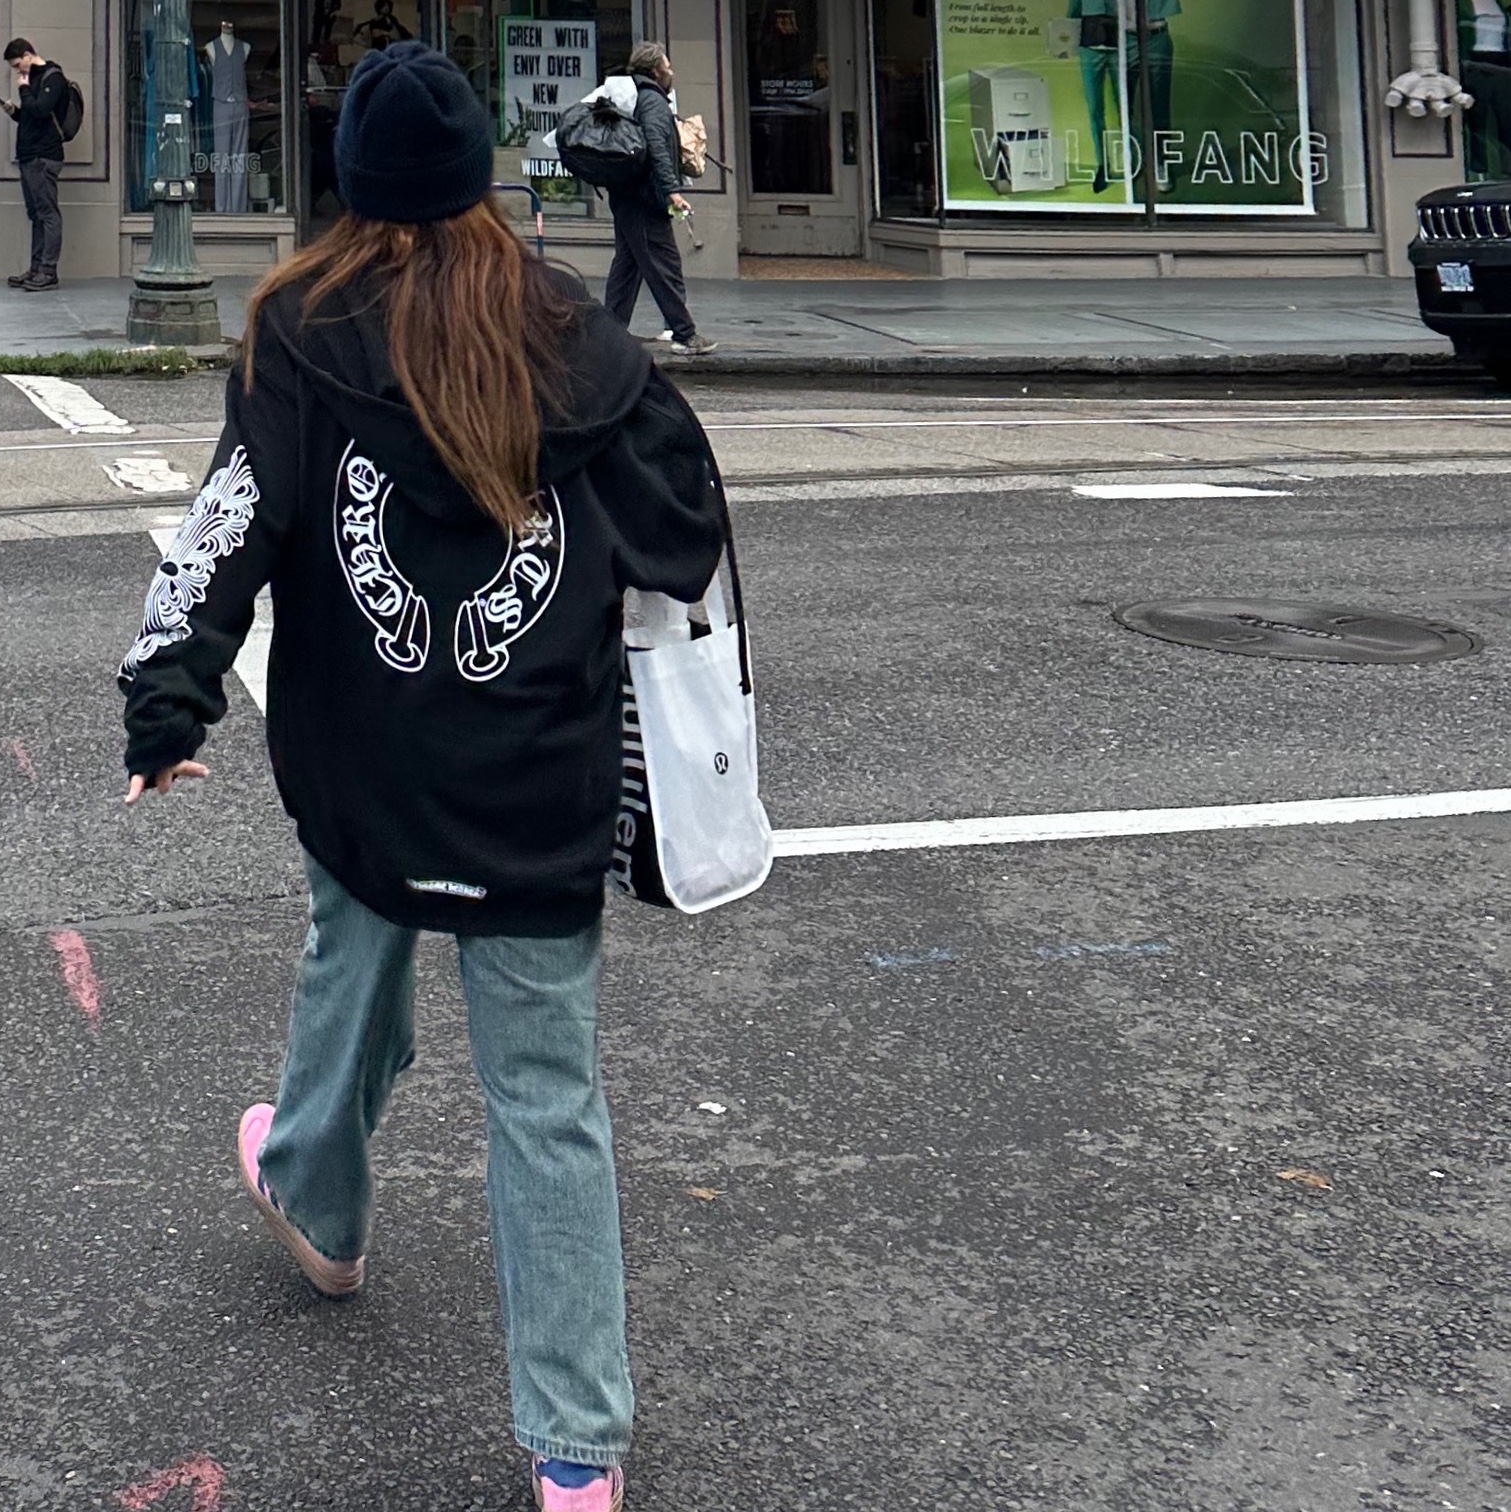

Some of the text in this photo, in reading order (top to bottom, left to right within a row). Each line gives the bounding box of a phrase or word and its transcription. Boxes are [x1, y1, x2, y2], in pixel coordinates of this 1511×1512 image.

[507, 25, 588, 49] GREEN WITH
[514, 55, 581, 78] ENVY OVER
[533, 84, 558, 105] NEW
[526, 109, 561, 133] UITIN
[190, 153, 261, 173] DFANG
[521, 158, 573, 177] WILDFA
[970, 128, 1328, 185] WILDFANG
[610, 684, 648, 898] lululem
